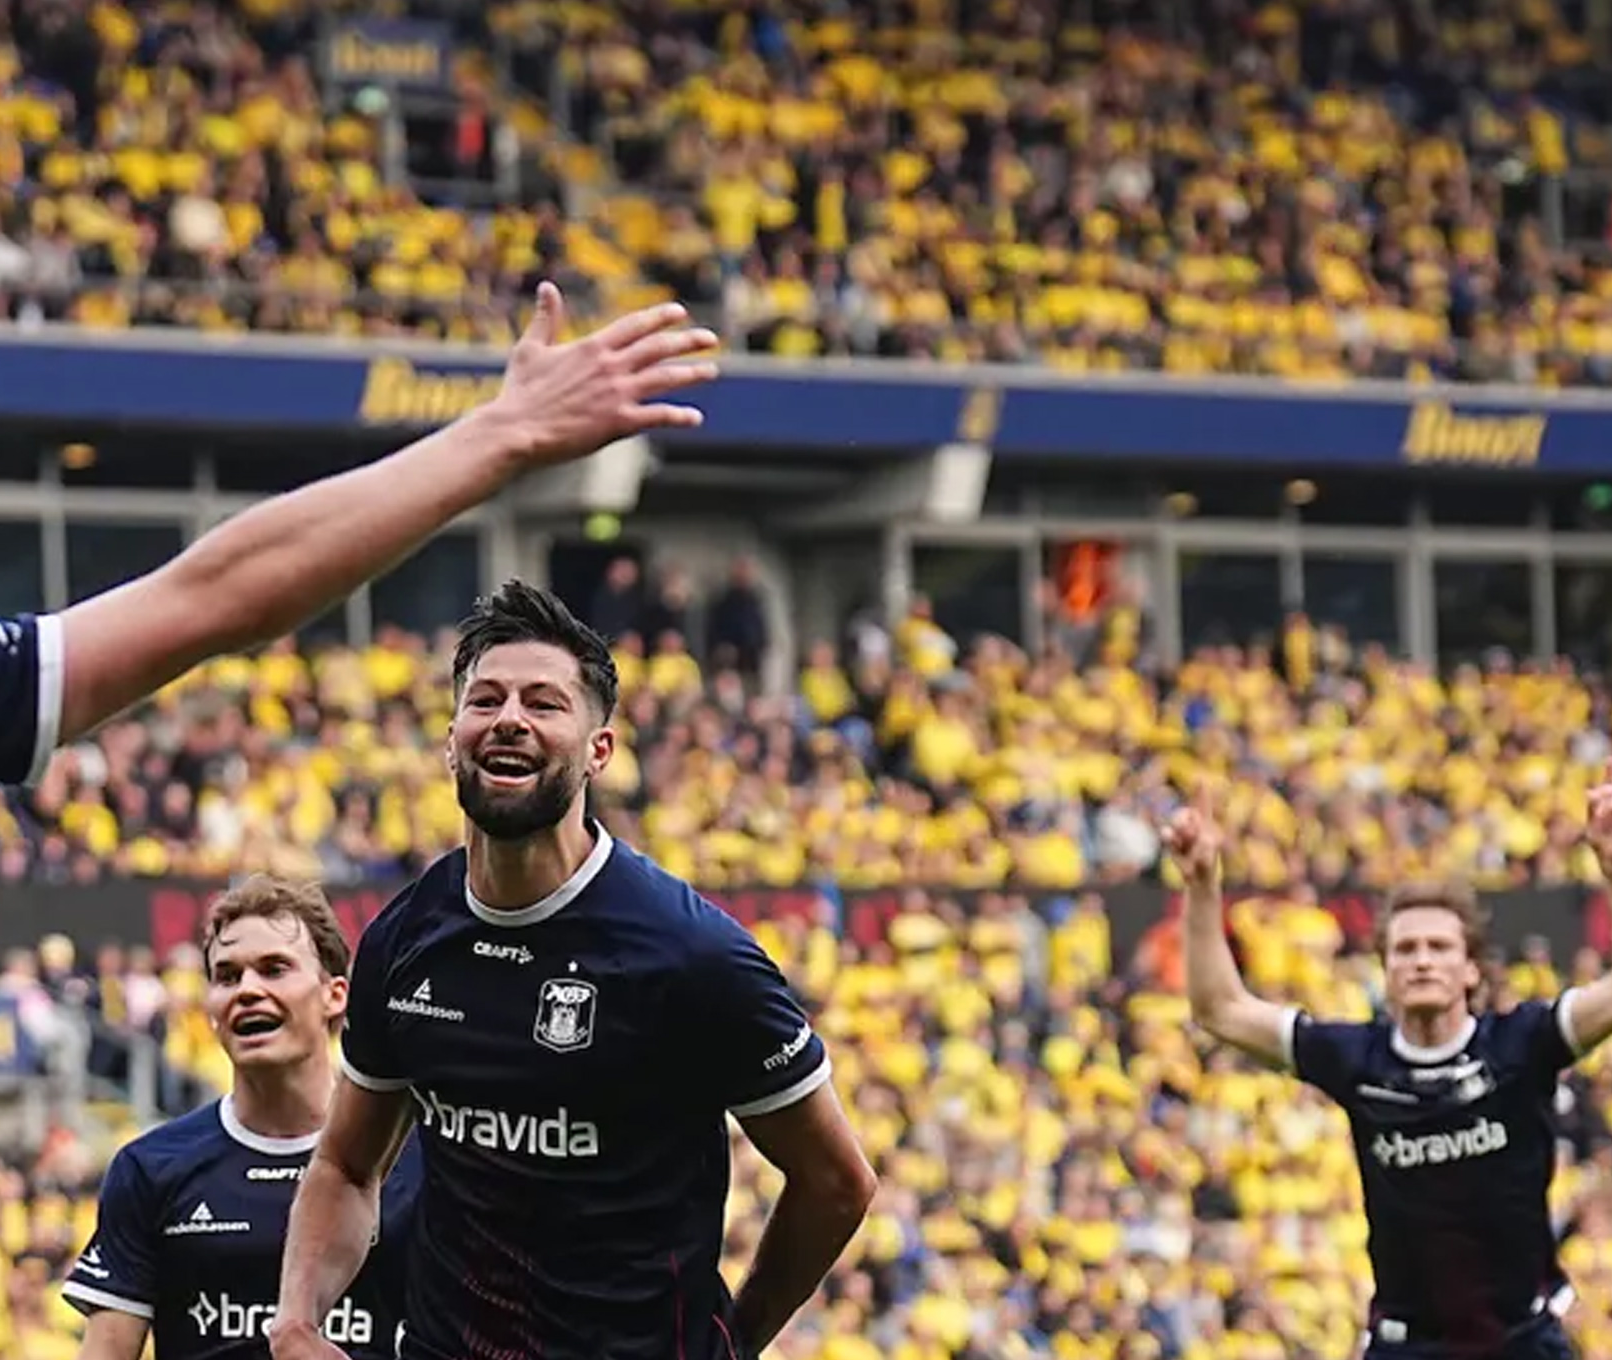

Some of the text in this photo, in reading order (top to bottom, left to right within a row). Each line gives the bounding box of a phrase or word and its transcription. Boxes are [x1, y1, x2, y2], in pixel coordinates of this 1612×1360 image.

[428, 1088, 600, 1160] bravida
[1395, 1117, 1508, 1167] bravida
[220, 1292, 373, 1343] brada
